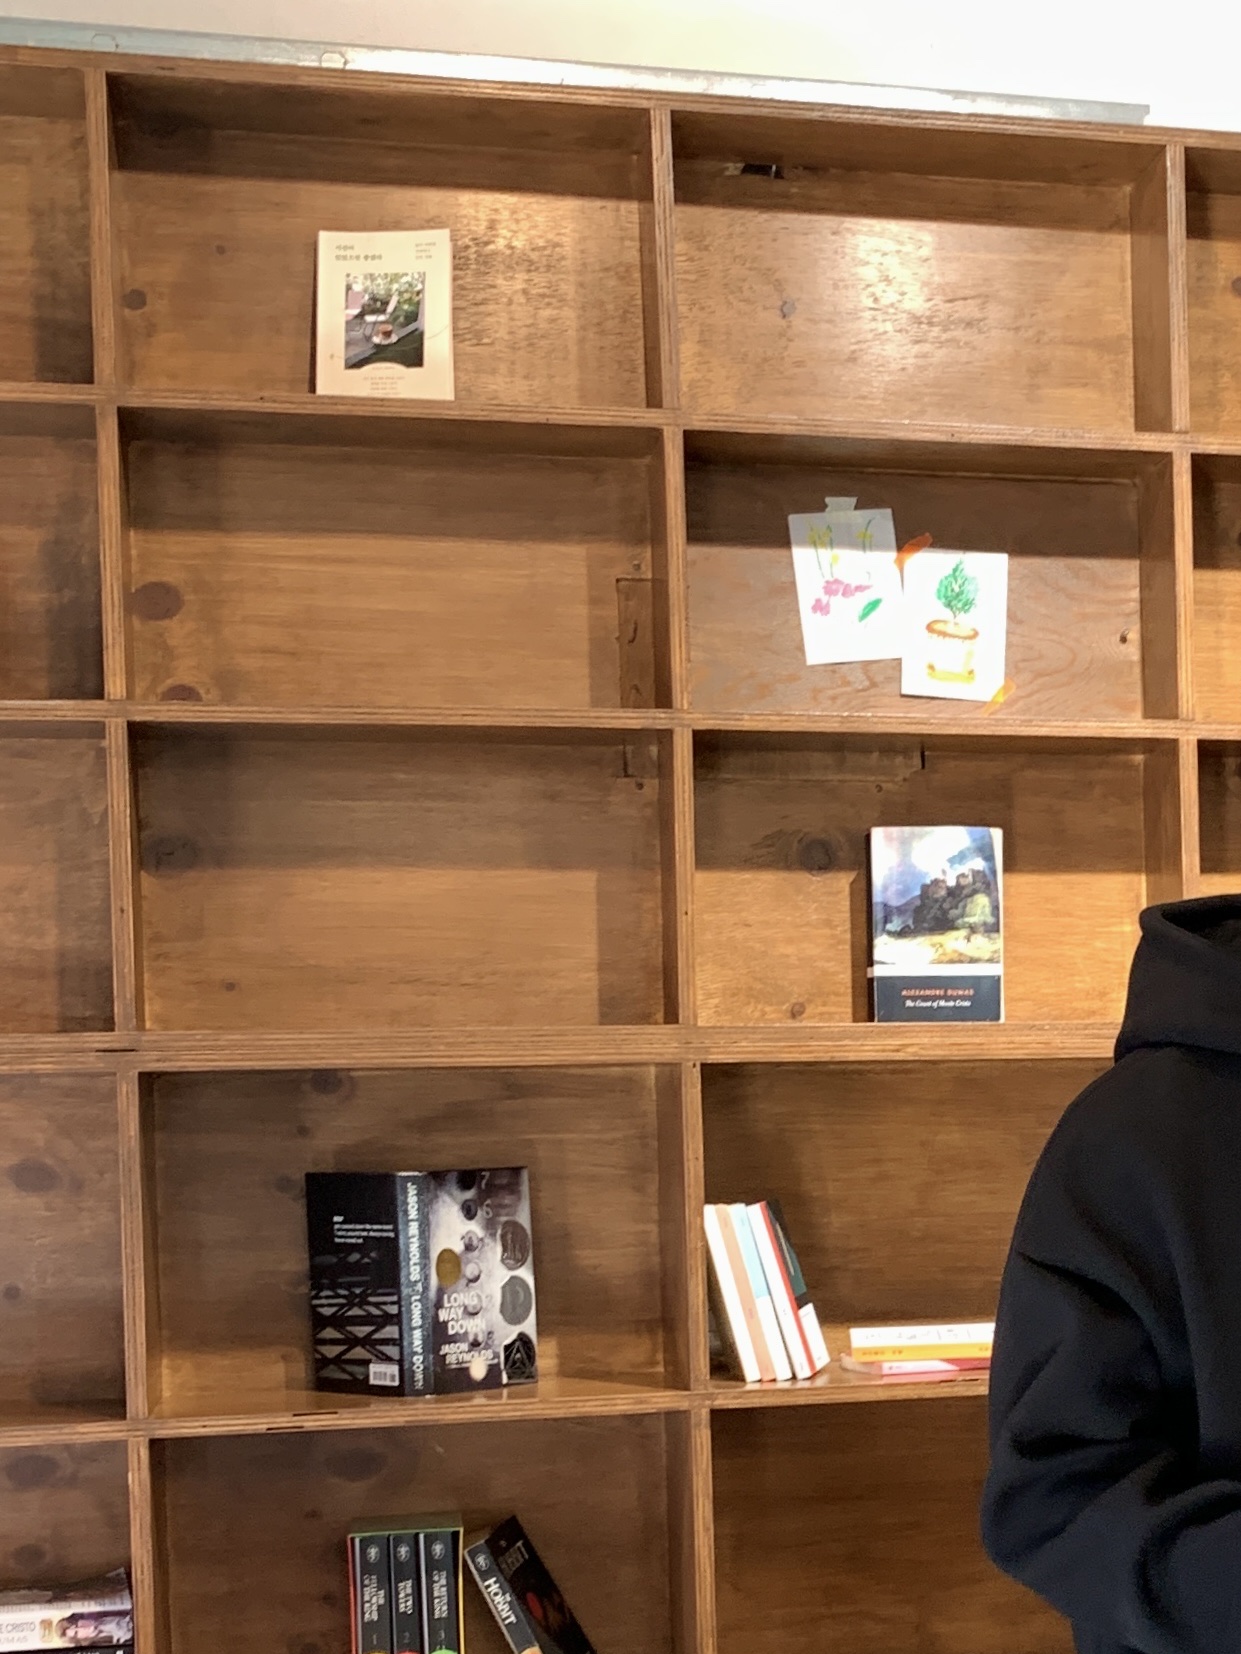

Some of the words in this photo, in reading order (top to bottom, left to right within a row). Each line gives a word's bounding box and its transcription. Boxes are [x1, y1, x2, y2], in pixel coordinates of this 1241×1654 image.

[407, 1182, 419, 1220] JASON
[408, 1221, 421, 1282] REYNOLDS
[411, 1294, 422, 1328] LONG
[438, 1306, 465, 1323] WAY
[443, 1291, 479, 1308] LONG
[412, 1328, 424, 1354] WAY
[447, 1318, 486, 1336] DOWN
[439, 1342, 469, 1355] JASON
[412, 1355, 424, 1390] DOWN
[483, 1576, 518, 1625] HOBBIT
